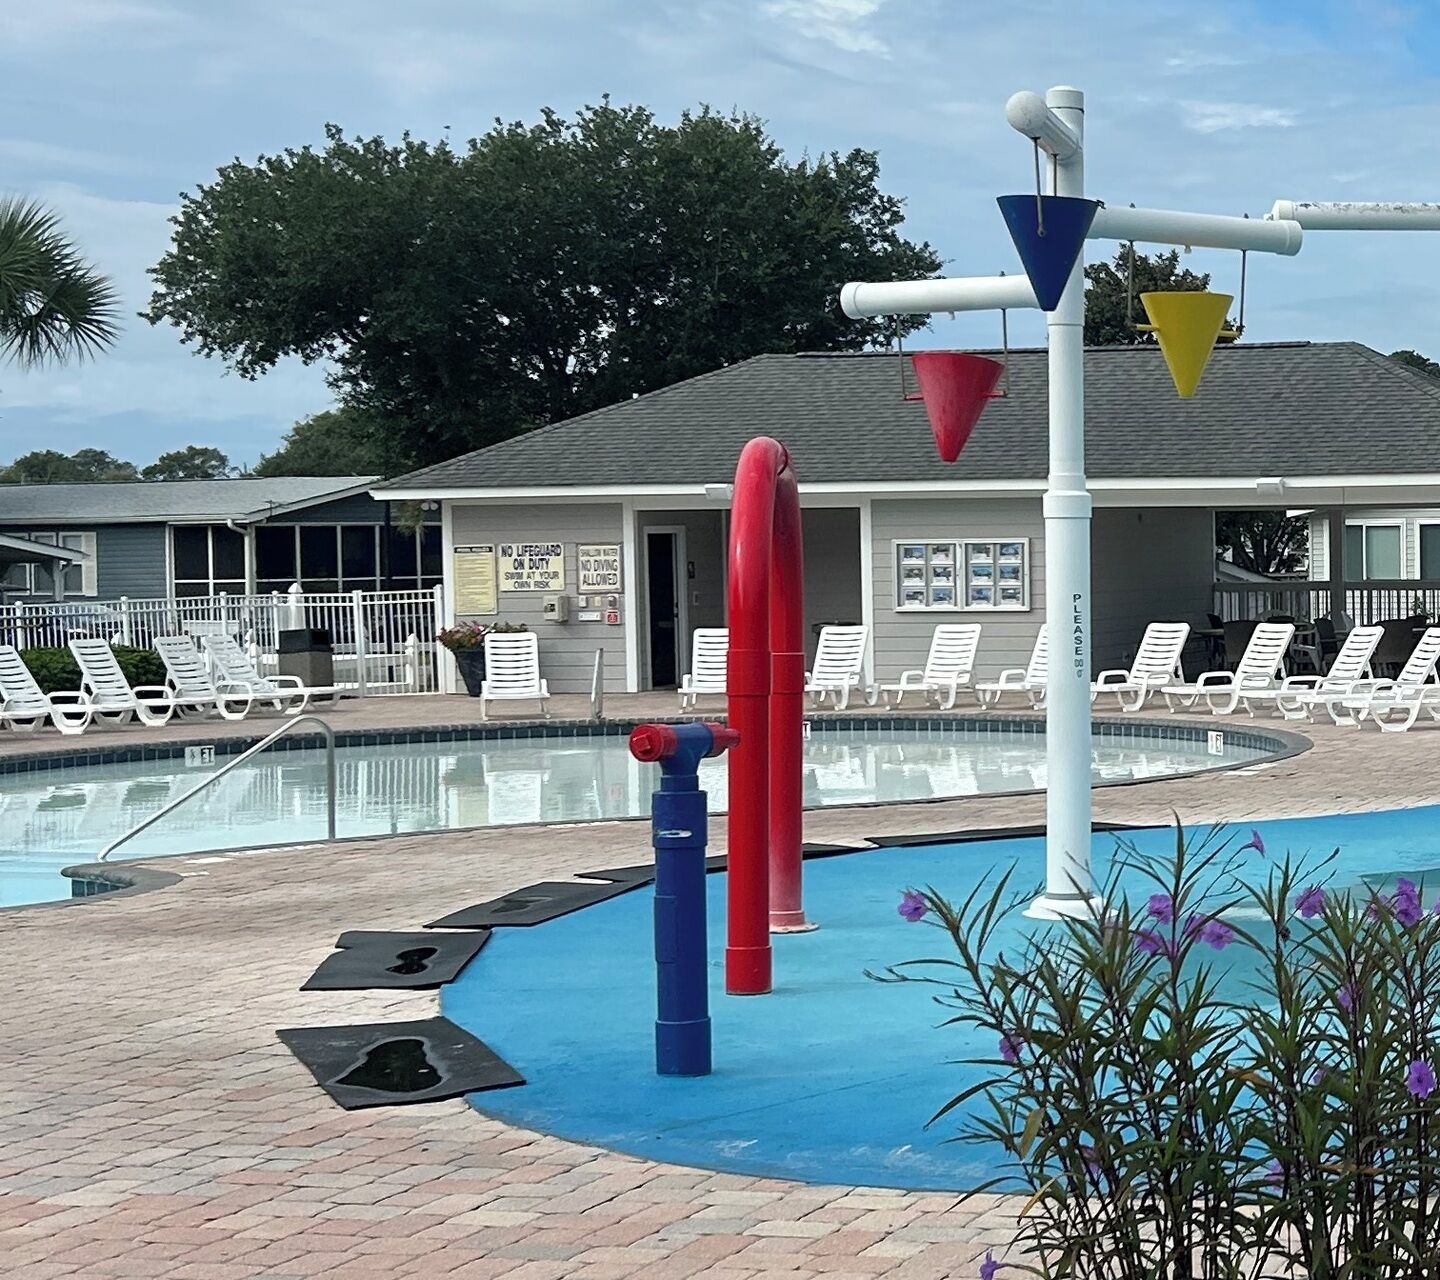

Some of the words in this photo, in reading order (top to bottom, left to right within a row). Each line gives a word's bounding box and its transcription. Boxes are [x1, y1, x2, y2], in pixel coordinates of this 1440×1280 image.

[501, 545, 513, 557] NO
[516, 544, 562, 557] LIFEGUARD
[513, 558, 525, 570] ON
[529, 557, 550, 570] DUTY
[581, 559, 591, 571] NO
[594, 558, 619, 571] DIVING
[504, 571, 523, 580] SWIM
[527, 571, 536, 580] AT
[539, 571, 560, 580] YOUR
[582, 573, 618, 586] ALLOWED
[513, 581, 531, 589] OWN
[1073, 593, 1083, 656] PLEASE
